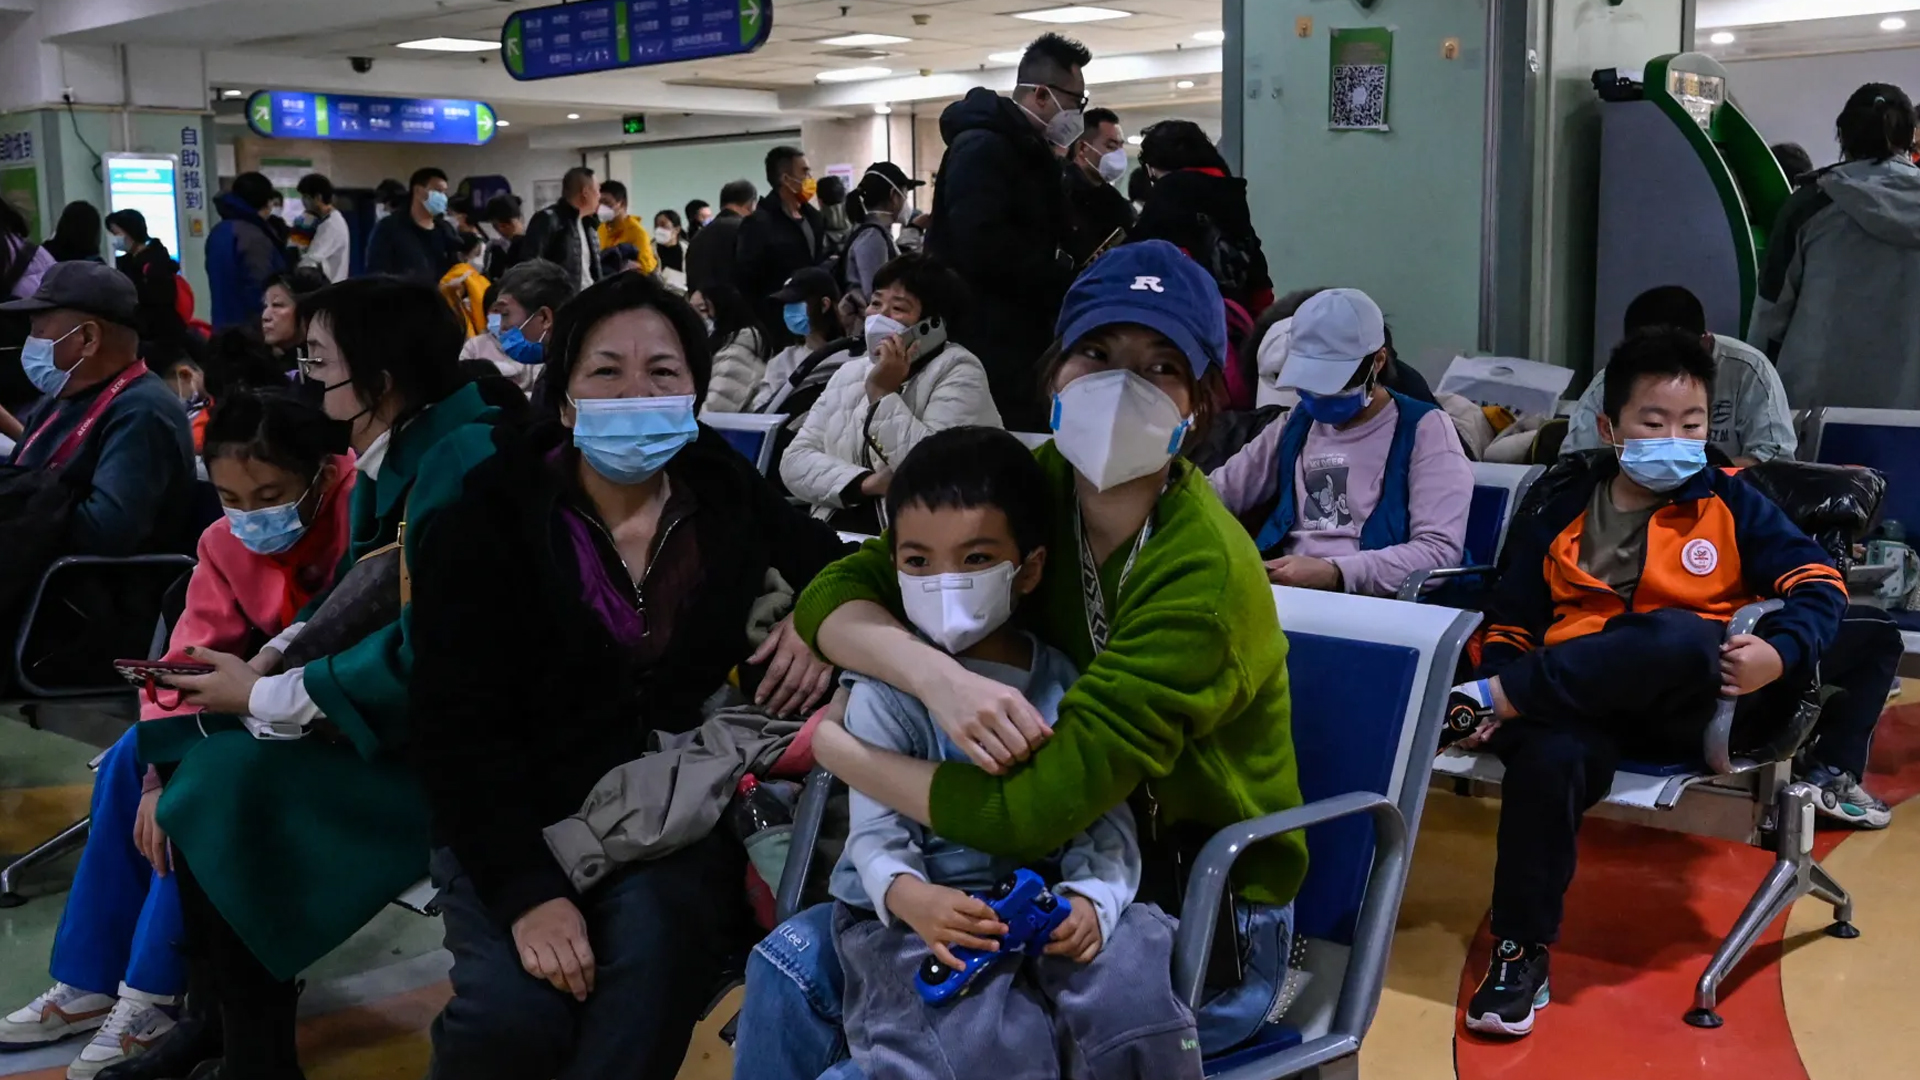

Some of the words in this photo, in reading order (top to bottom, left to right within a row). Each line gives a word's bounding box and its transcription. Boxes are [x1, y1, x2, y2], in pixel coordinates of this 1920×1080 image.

[181, 127, 203, 210] 自助报到
[1130, 276, 1164, 293] R
